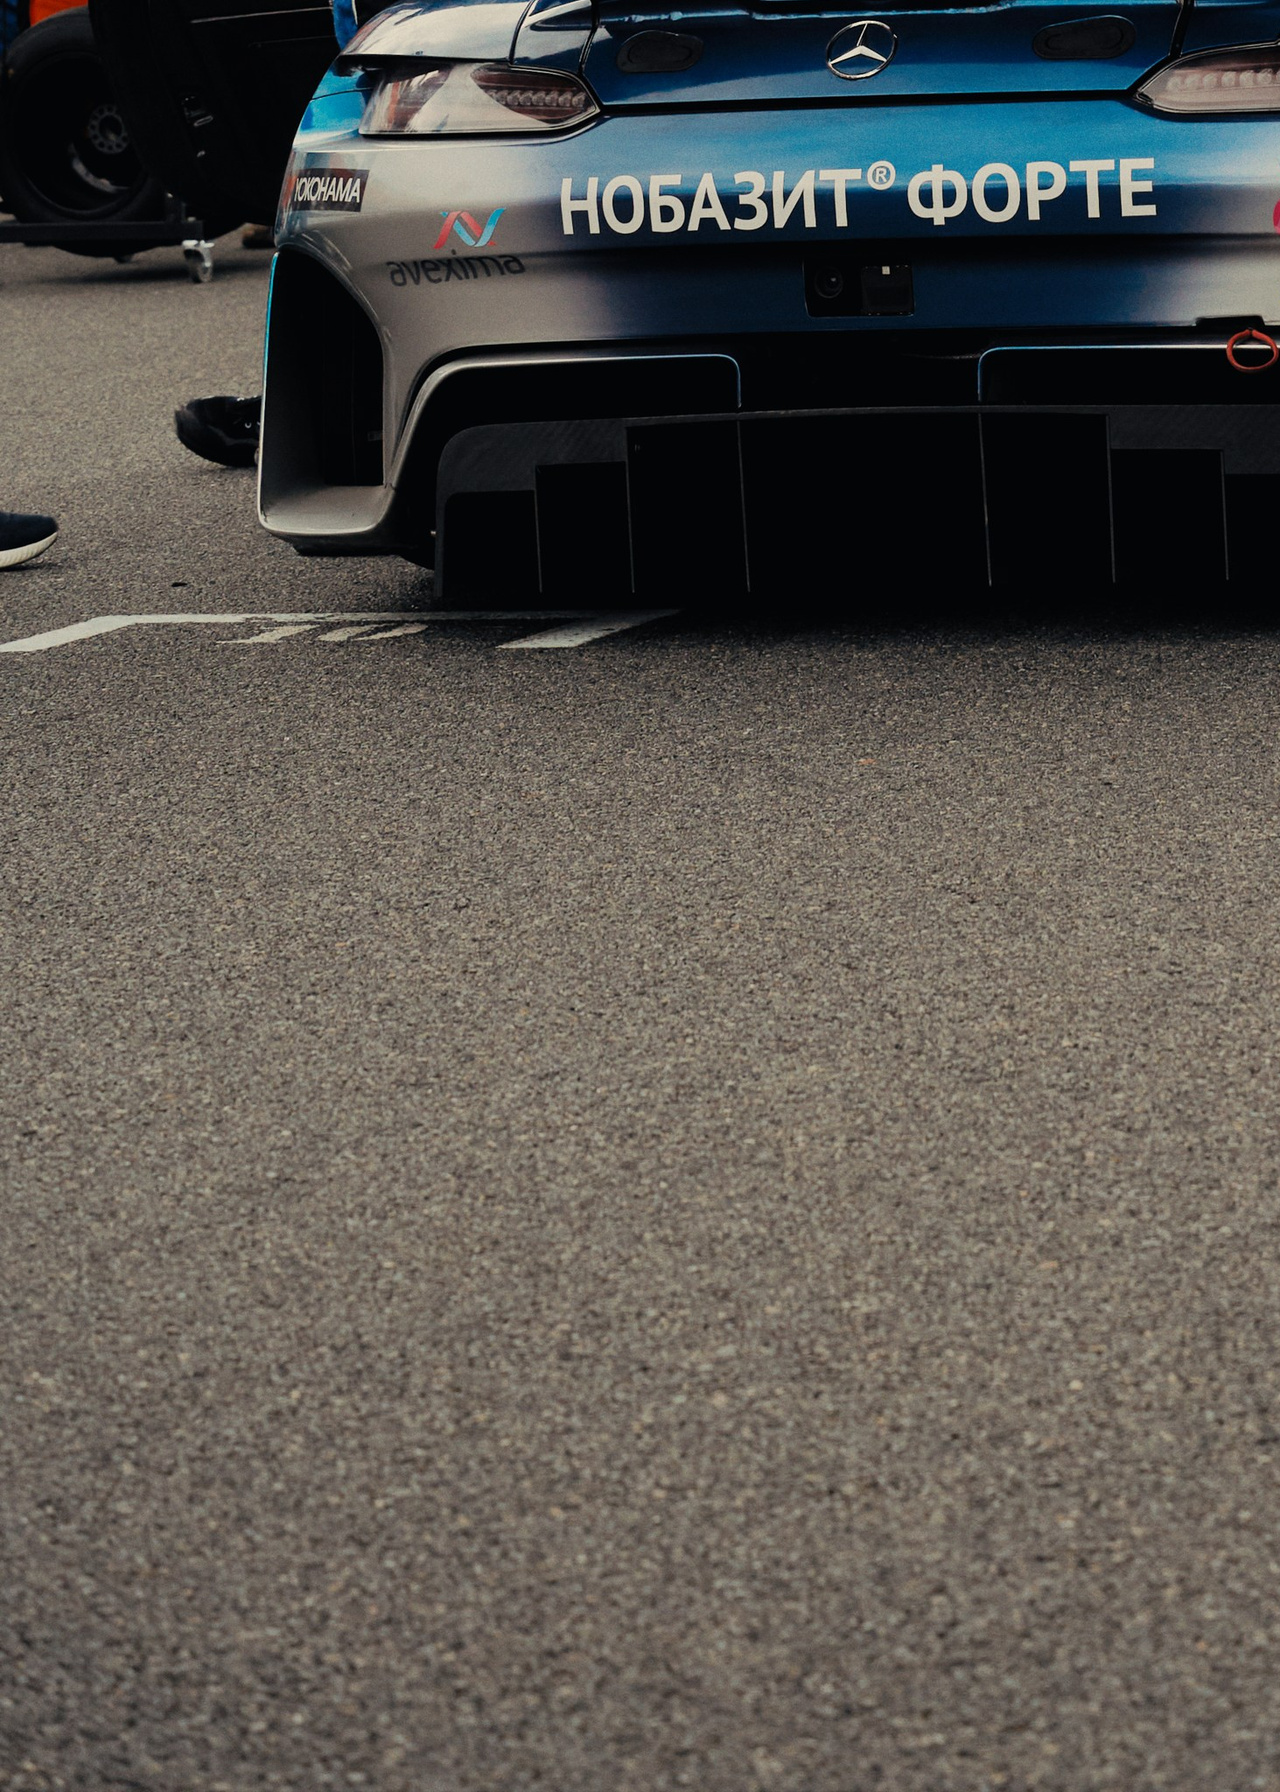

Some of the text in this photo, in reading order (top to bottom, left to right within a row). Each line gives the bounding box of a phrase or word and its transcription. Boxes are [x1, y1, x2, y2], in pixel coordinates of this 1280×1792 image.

[294, 175, 361, 203] YOKOHAMA
[560, 157, 1157, 236] НОБАЗИТ® ФОРТЕ
[386, 249, 526, 287] avexima
